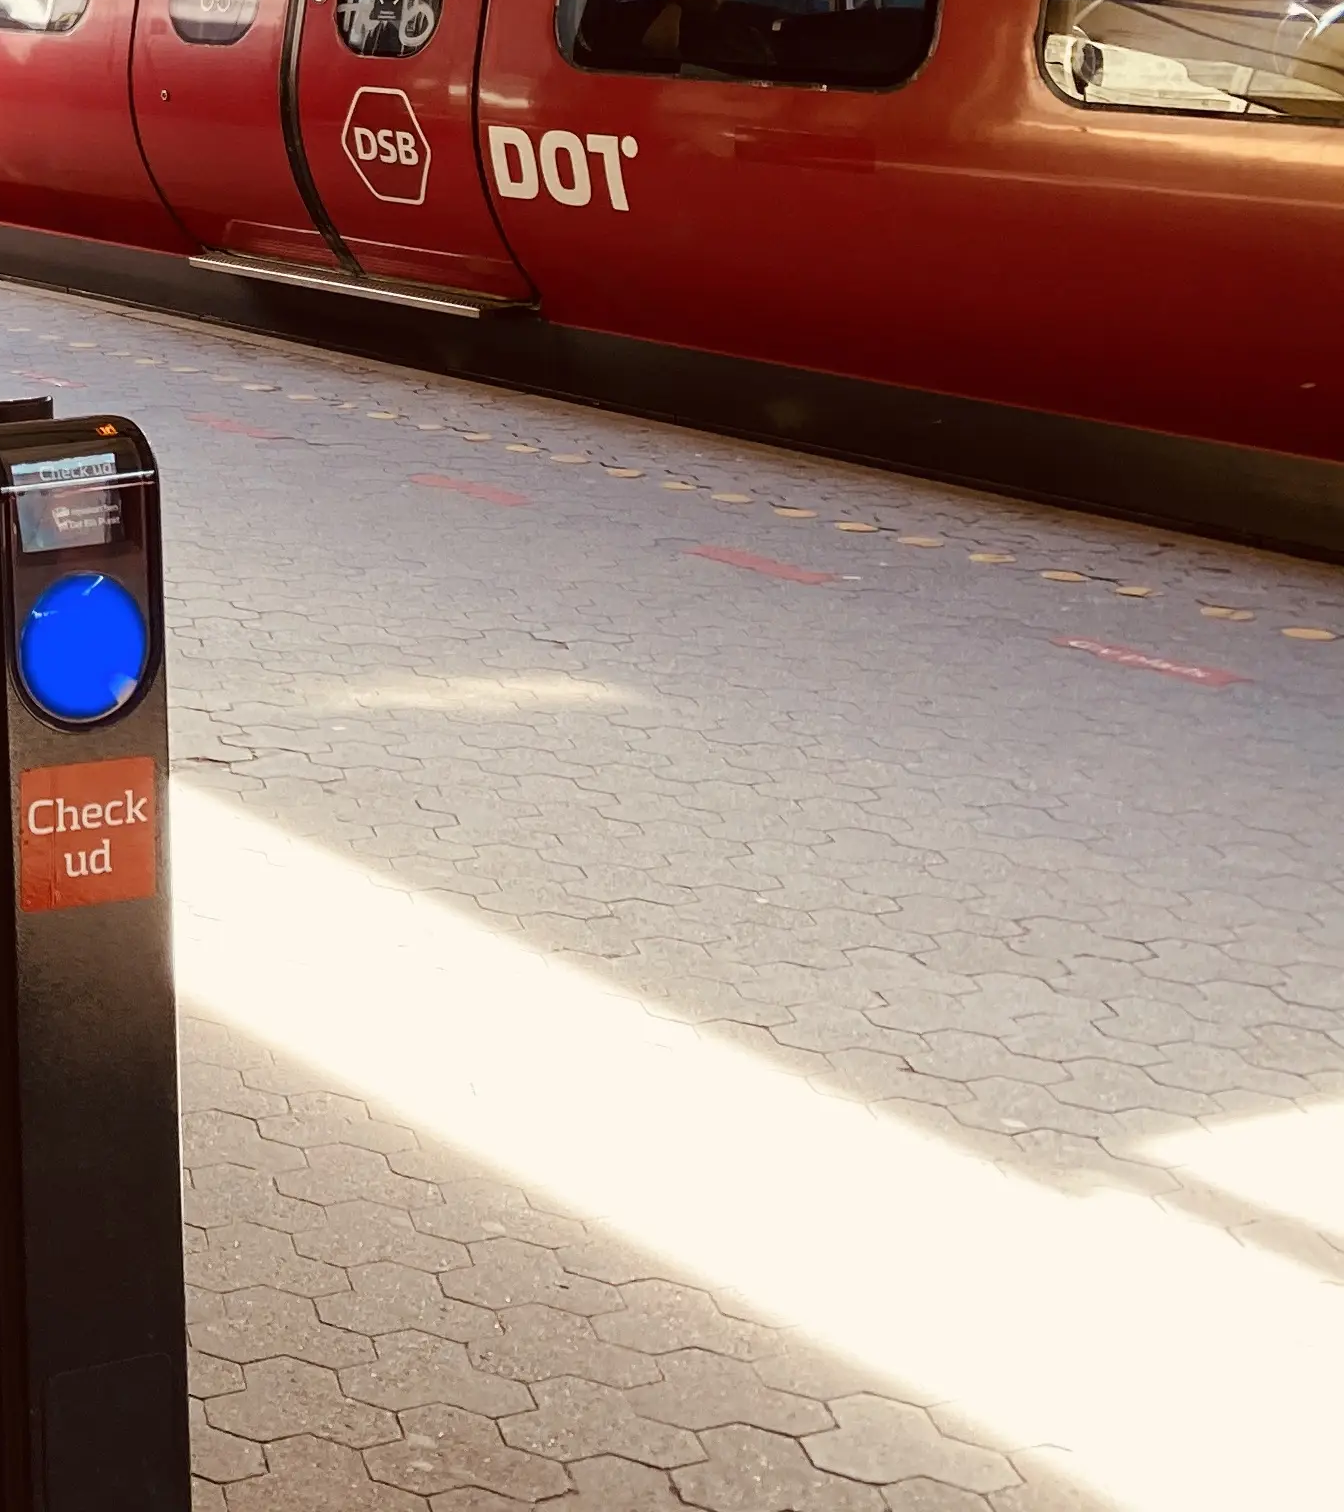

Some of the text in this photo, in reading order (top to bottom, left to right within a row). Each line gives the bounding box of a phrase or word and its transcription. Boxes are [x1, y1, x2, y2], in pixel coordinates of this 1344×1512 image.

[353, 127, 419, 166] DSB
[488, 125, 638, 211] DOT
[40, 462, 89, 482] Check
[27, 790, 148, 836] Check
[64, 839, 113, 878] ud
